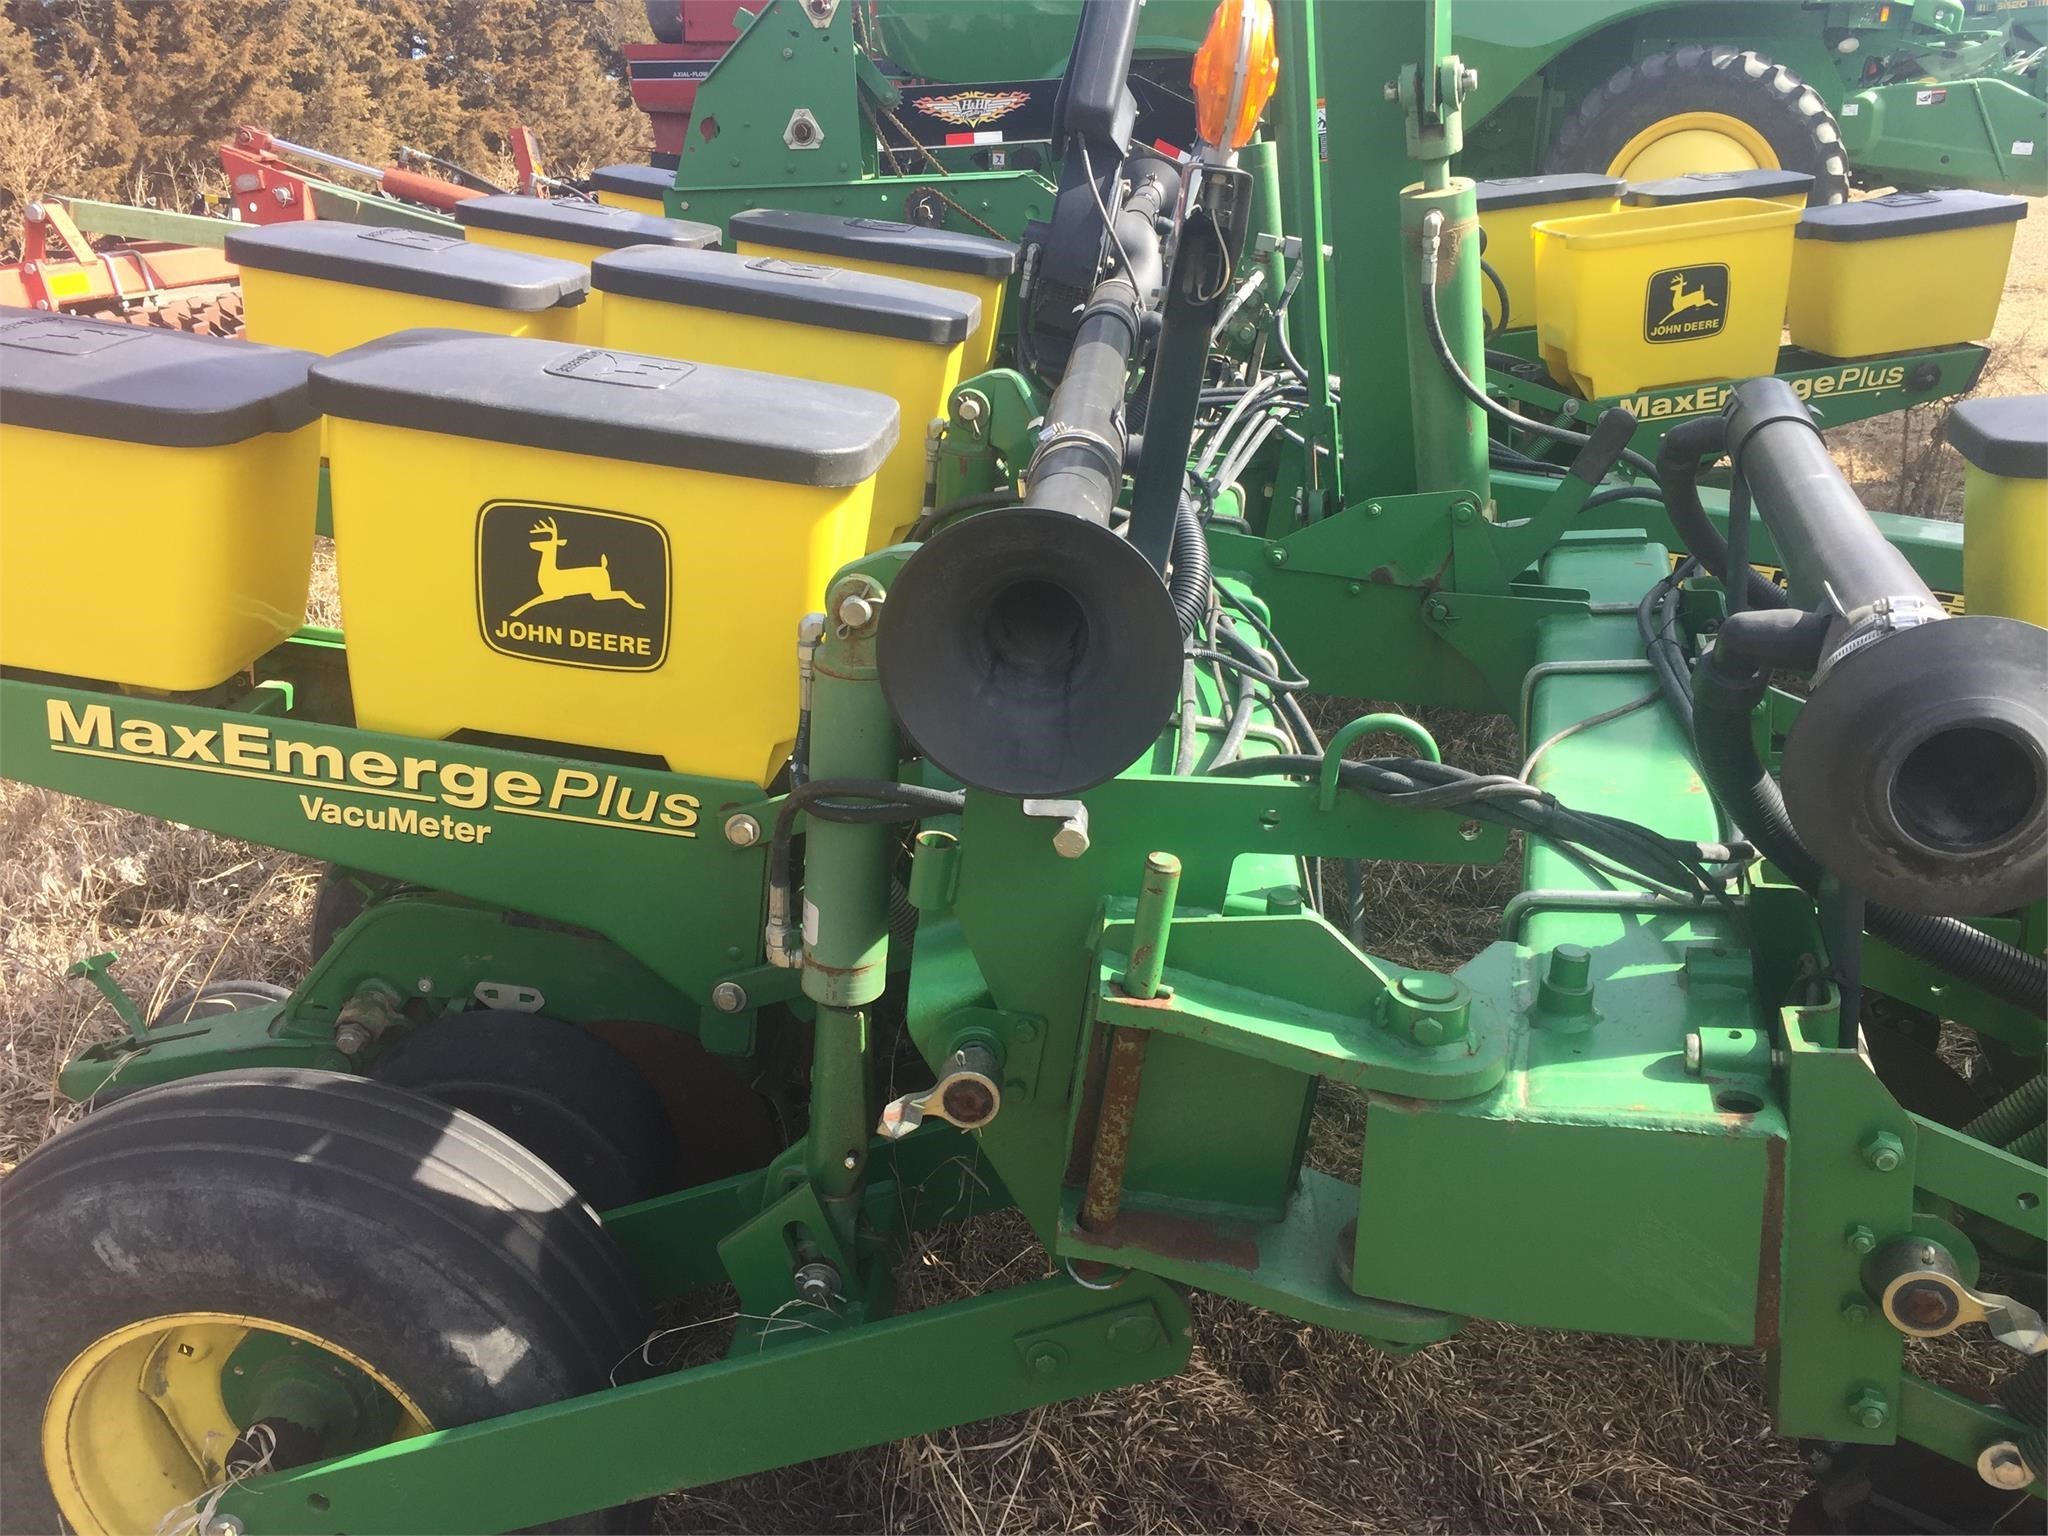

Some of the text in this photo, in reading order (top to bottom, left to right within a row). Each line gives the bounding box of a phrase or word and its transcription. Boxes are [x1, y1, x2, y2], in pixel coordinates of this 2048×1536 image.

[1650, 318, 1720, 337] JOHN DEERE
[495, 620, 652, 656] JOHN DEERE
[46, 699, 701, 829] MaxEmergePlus
[299, 795, 492, 845] VacuMeter
